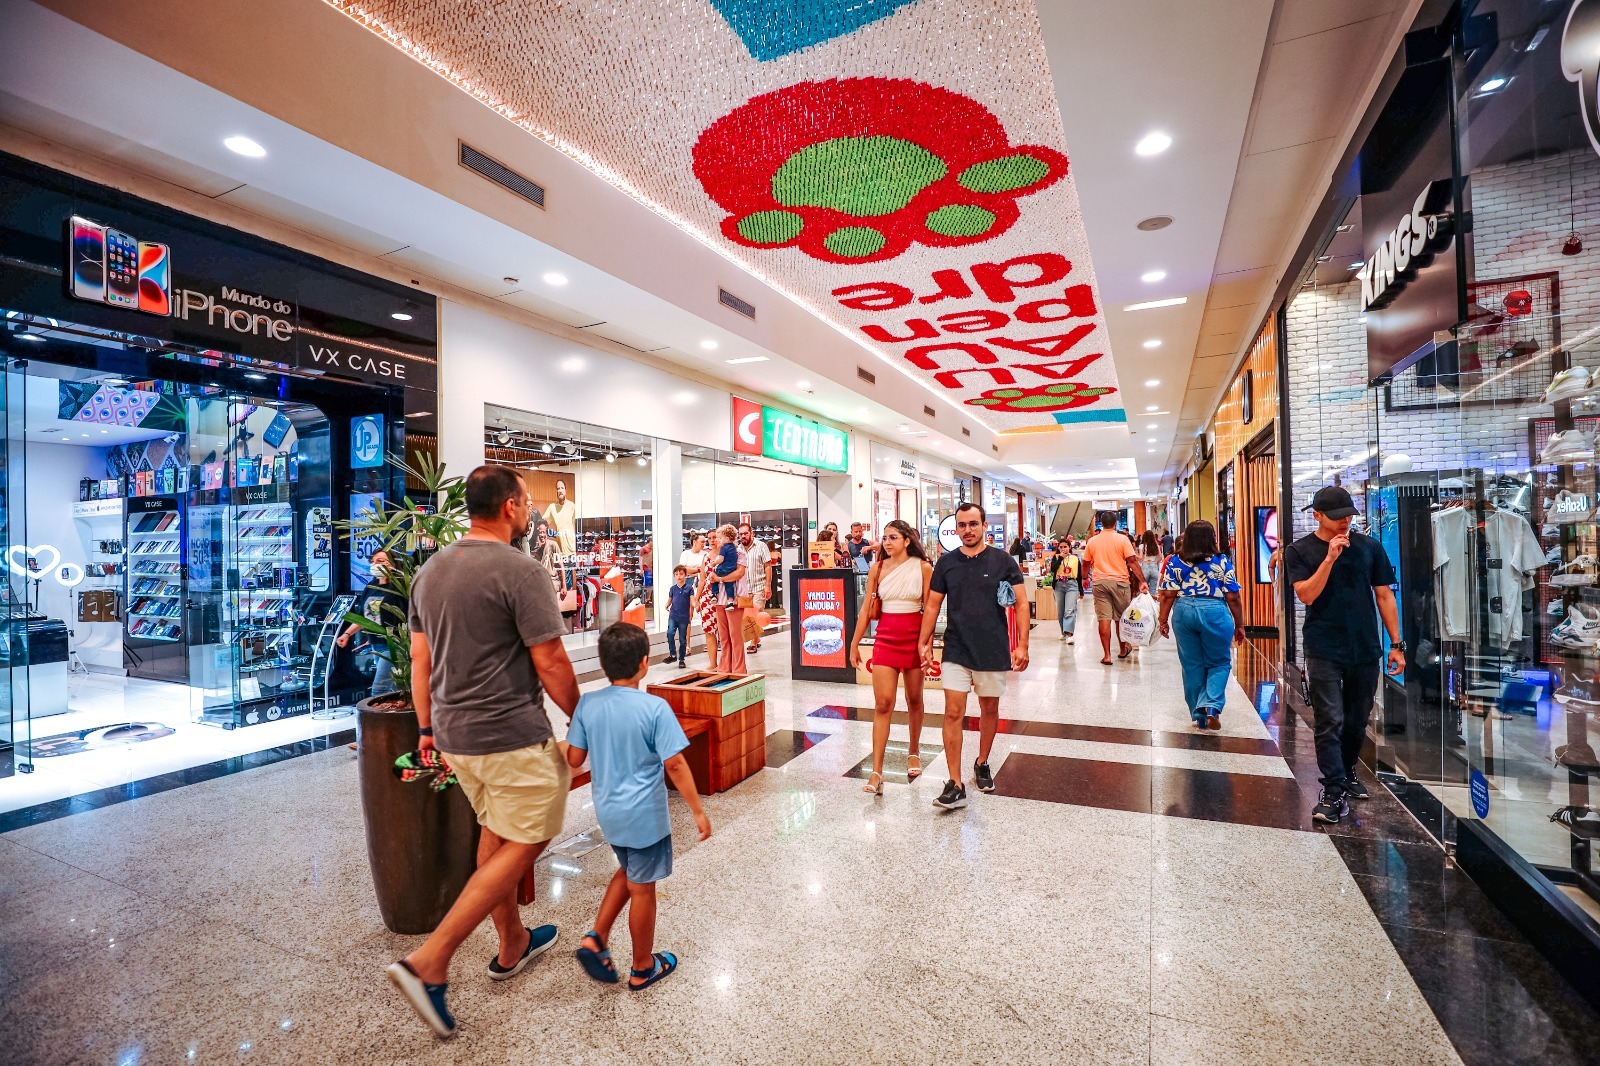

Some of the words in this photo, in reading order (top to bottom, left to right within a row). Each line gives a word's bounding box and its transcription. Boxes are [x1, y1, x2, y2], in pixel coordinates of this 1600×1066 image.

[1356, 181, 1428, 312] KINGS
[221, 285, 271, 310] Mundo
[272, 301, 291, 315] do
[173, 288, 293, 342] iPhone
[309, 344, 340, 367] VX
[348, 354, 406, 379] CASE
[253, 491, 268, 499] CASE
[600, 541, 615, 549] 30%
[553, 552, 569, 563] Dia
[570, 552, 588, 563] dos
[807, 591, 825, 601] VAMO
[826, 591, 836, 601] DE
[804, 601, 835, 611] SANDUBA
[836, 601, 841, 611] ?
